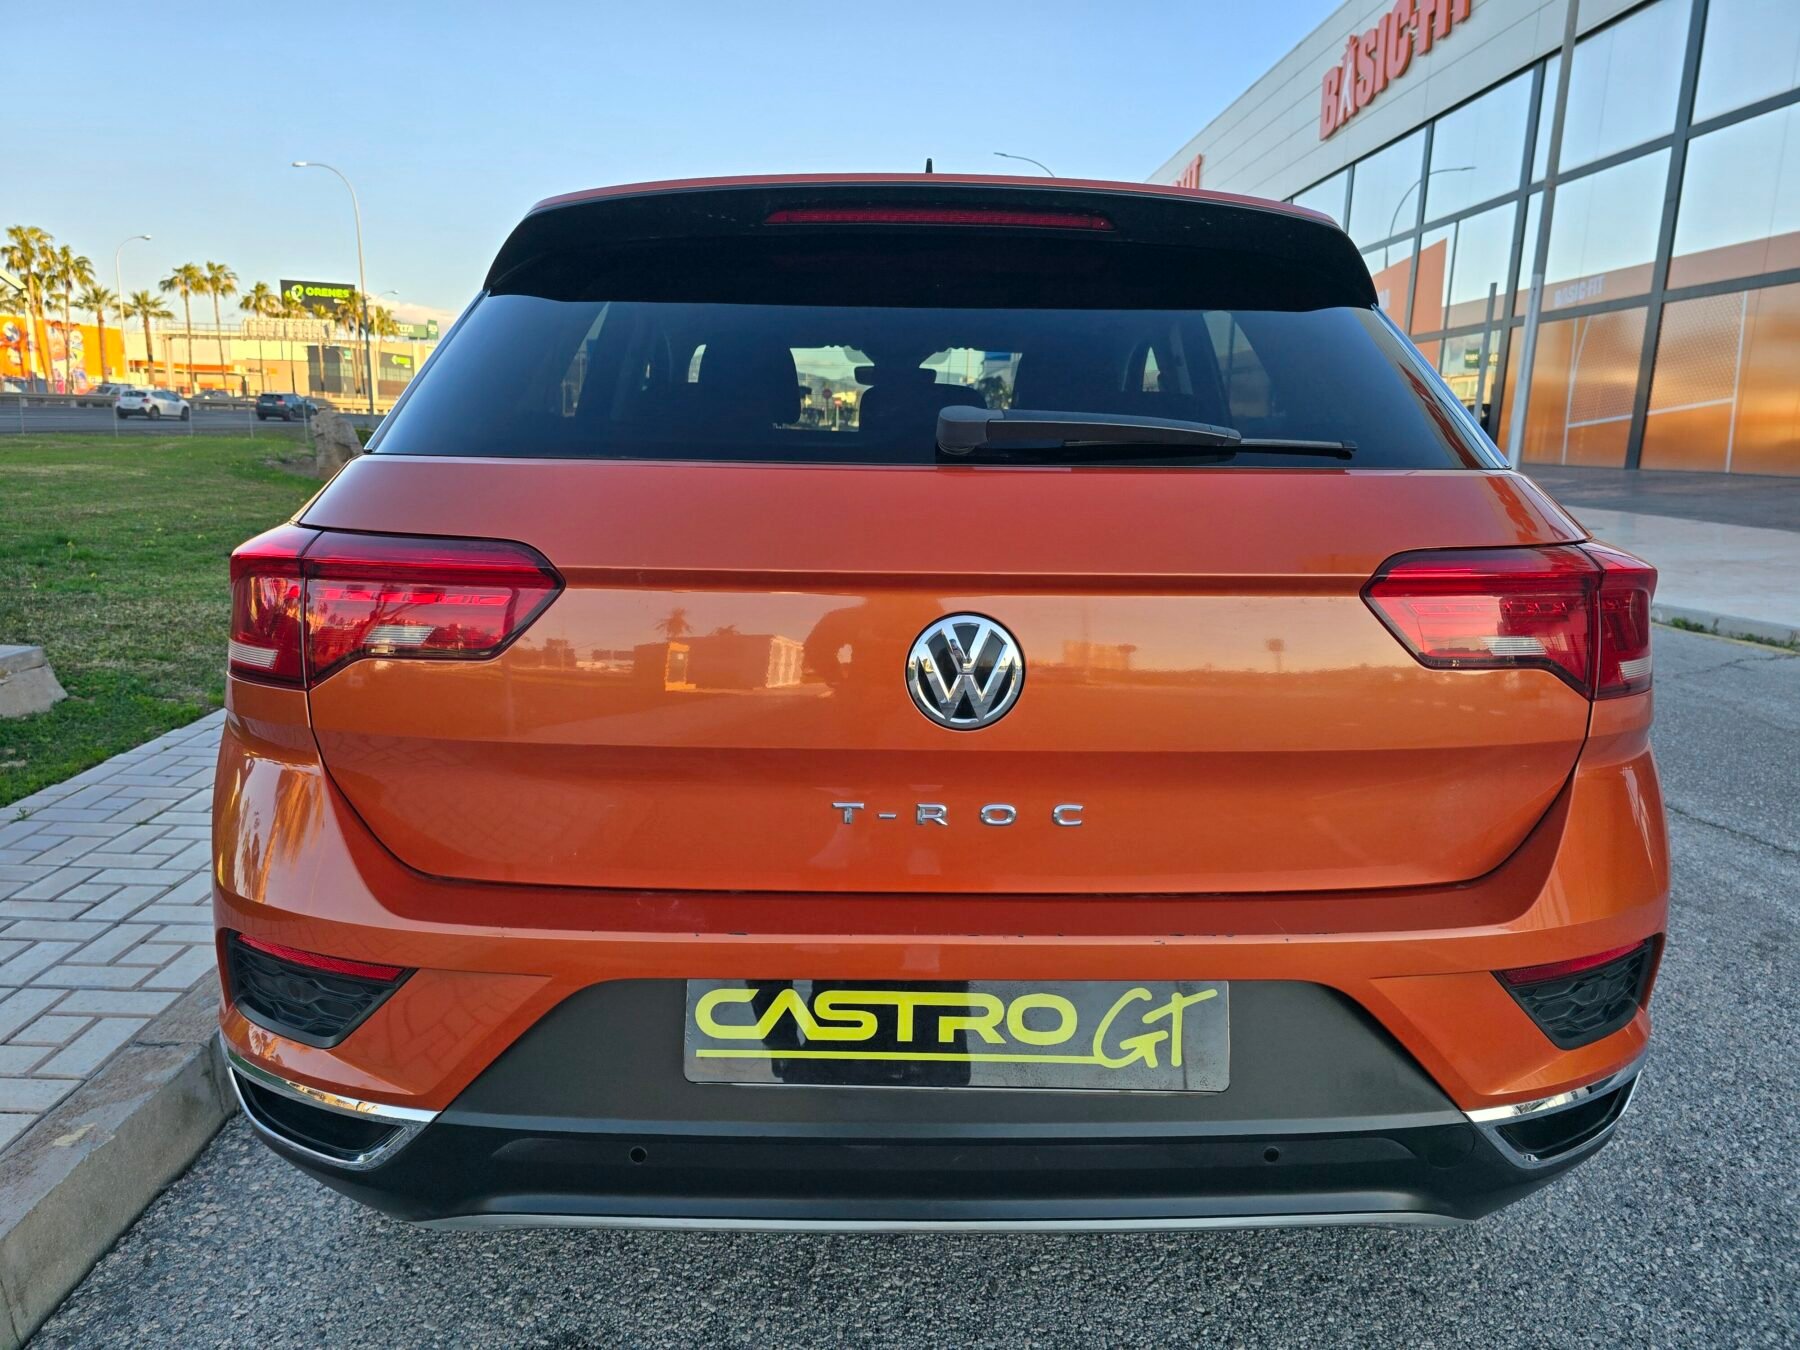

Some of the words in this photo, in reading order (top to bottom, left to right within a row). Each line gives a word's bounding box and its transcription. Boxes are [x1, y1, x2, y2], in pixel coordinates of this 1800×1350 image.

[305, 286, 350, 298] ORENES
[832, 802, 1084, 826] T-ROC
[695, 988, 1078, 1046] CASTRO
[1093, 987, 1218, 1069] GT
